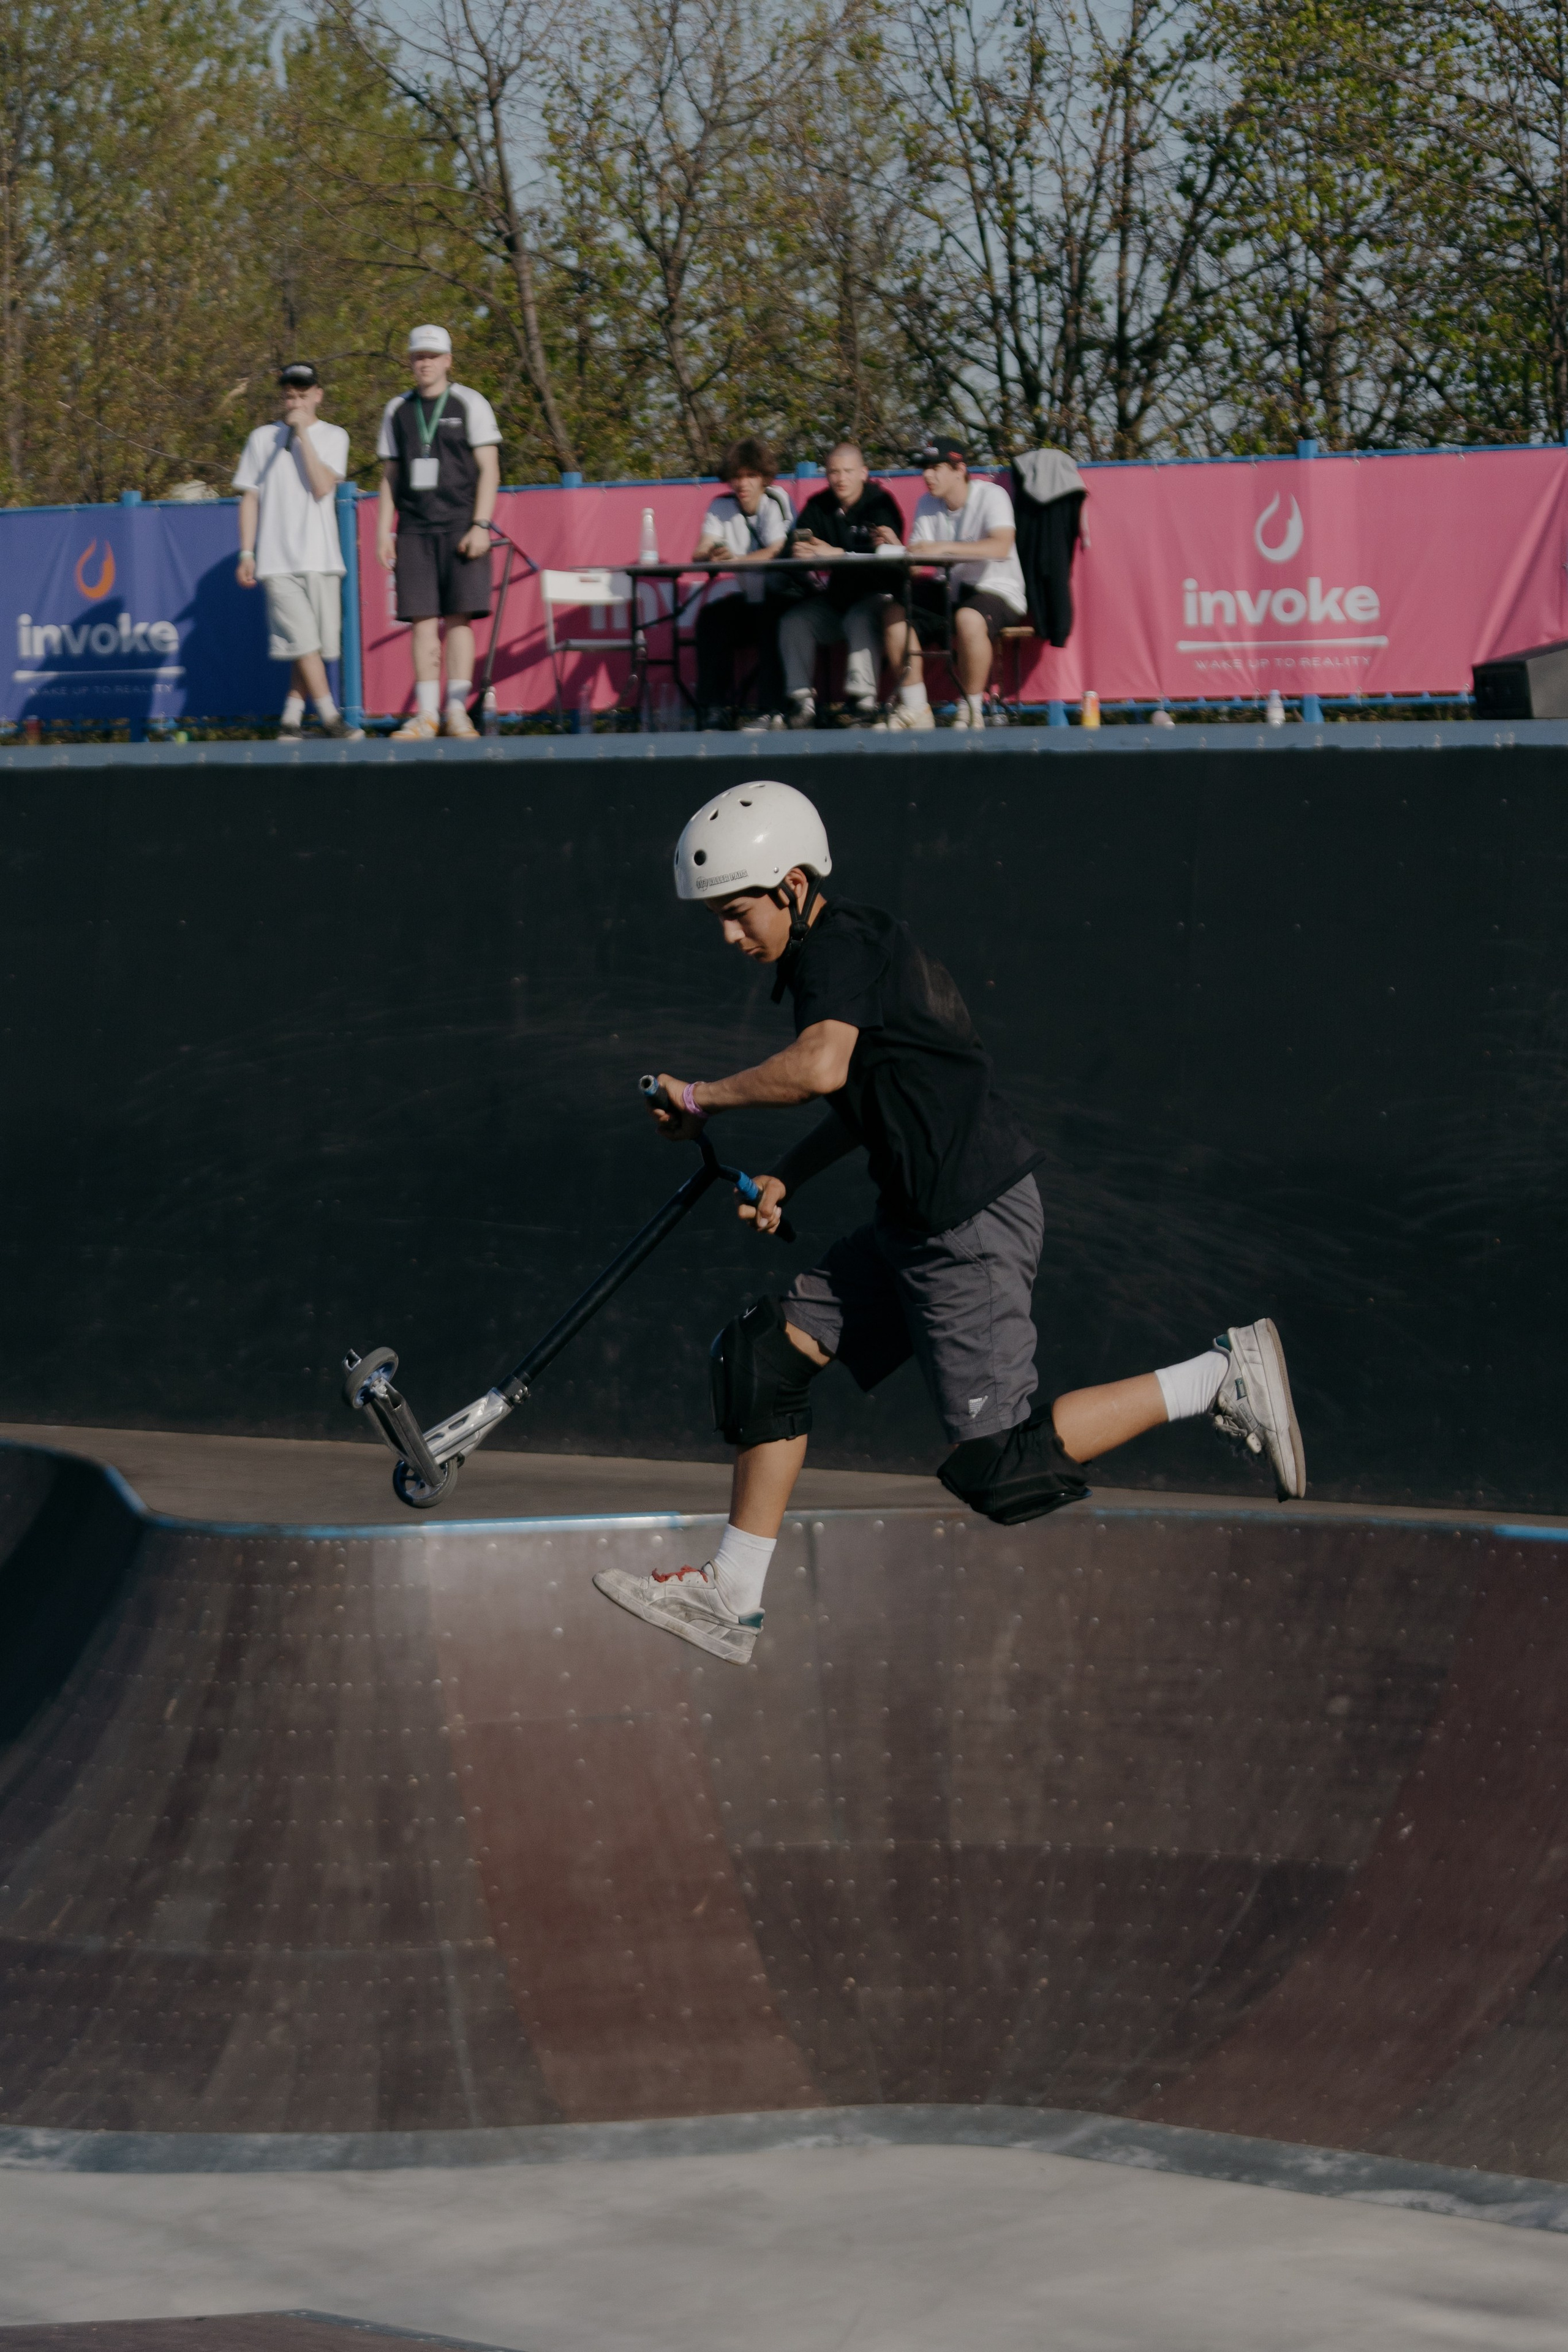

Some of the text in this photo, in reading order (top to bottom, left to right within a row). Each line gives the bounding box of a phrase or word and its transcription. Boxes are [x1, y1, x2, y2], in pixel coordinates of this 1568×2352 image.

[1183, 576, 1381, 627] invoke
[18, 612, 179, 657] invoke
[1194, 655, 1371, 670] WAKE UP TO REALITY
[115, 684, 173, 693] REALTY
[708, 873, 730, 886] KILLER
